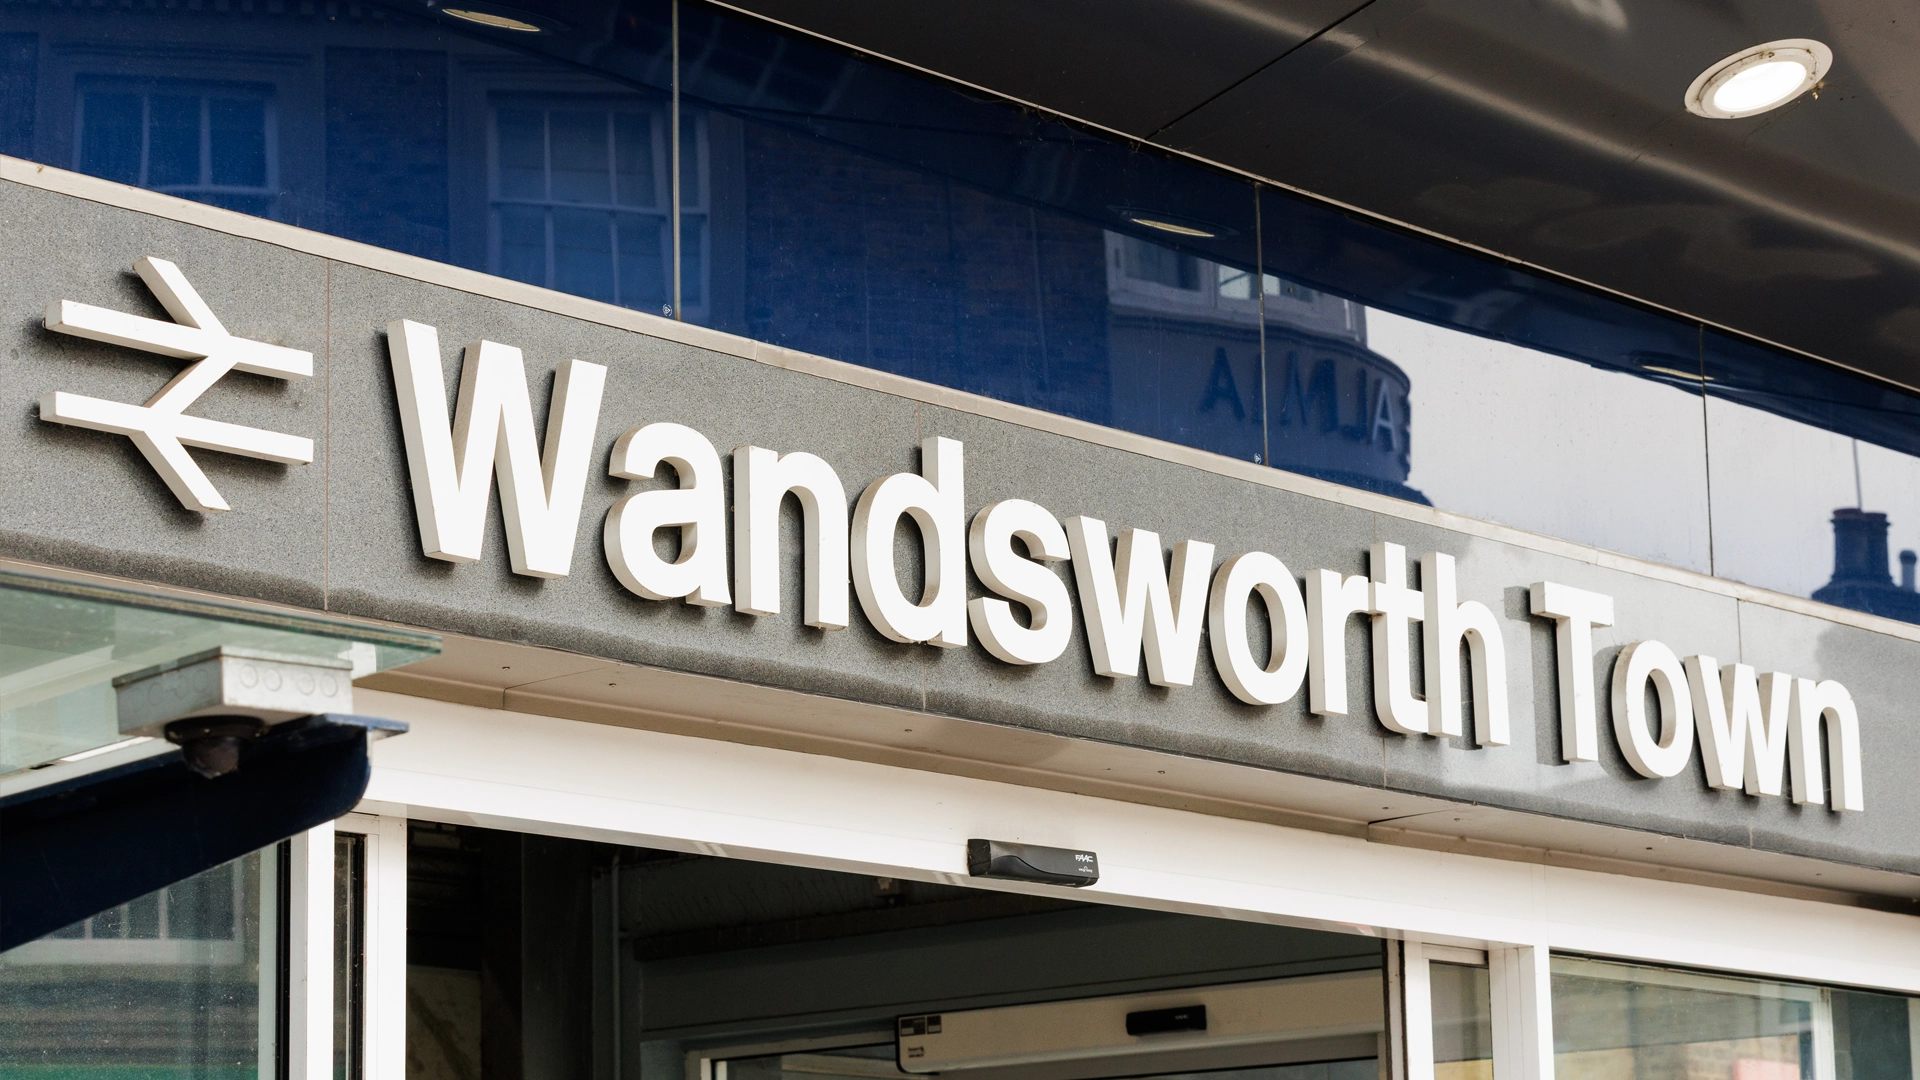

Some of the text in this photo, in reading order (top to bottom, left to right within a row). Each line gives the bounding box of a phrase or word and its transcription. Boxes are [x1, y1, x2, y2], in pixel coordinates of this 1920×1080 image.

[387, 319, 1865, 812] Wandsworth Town
[1075, 854, 1094, 862] FAAC
